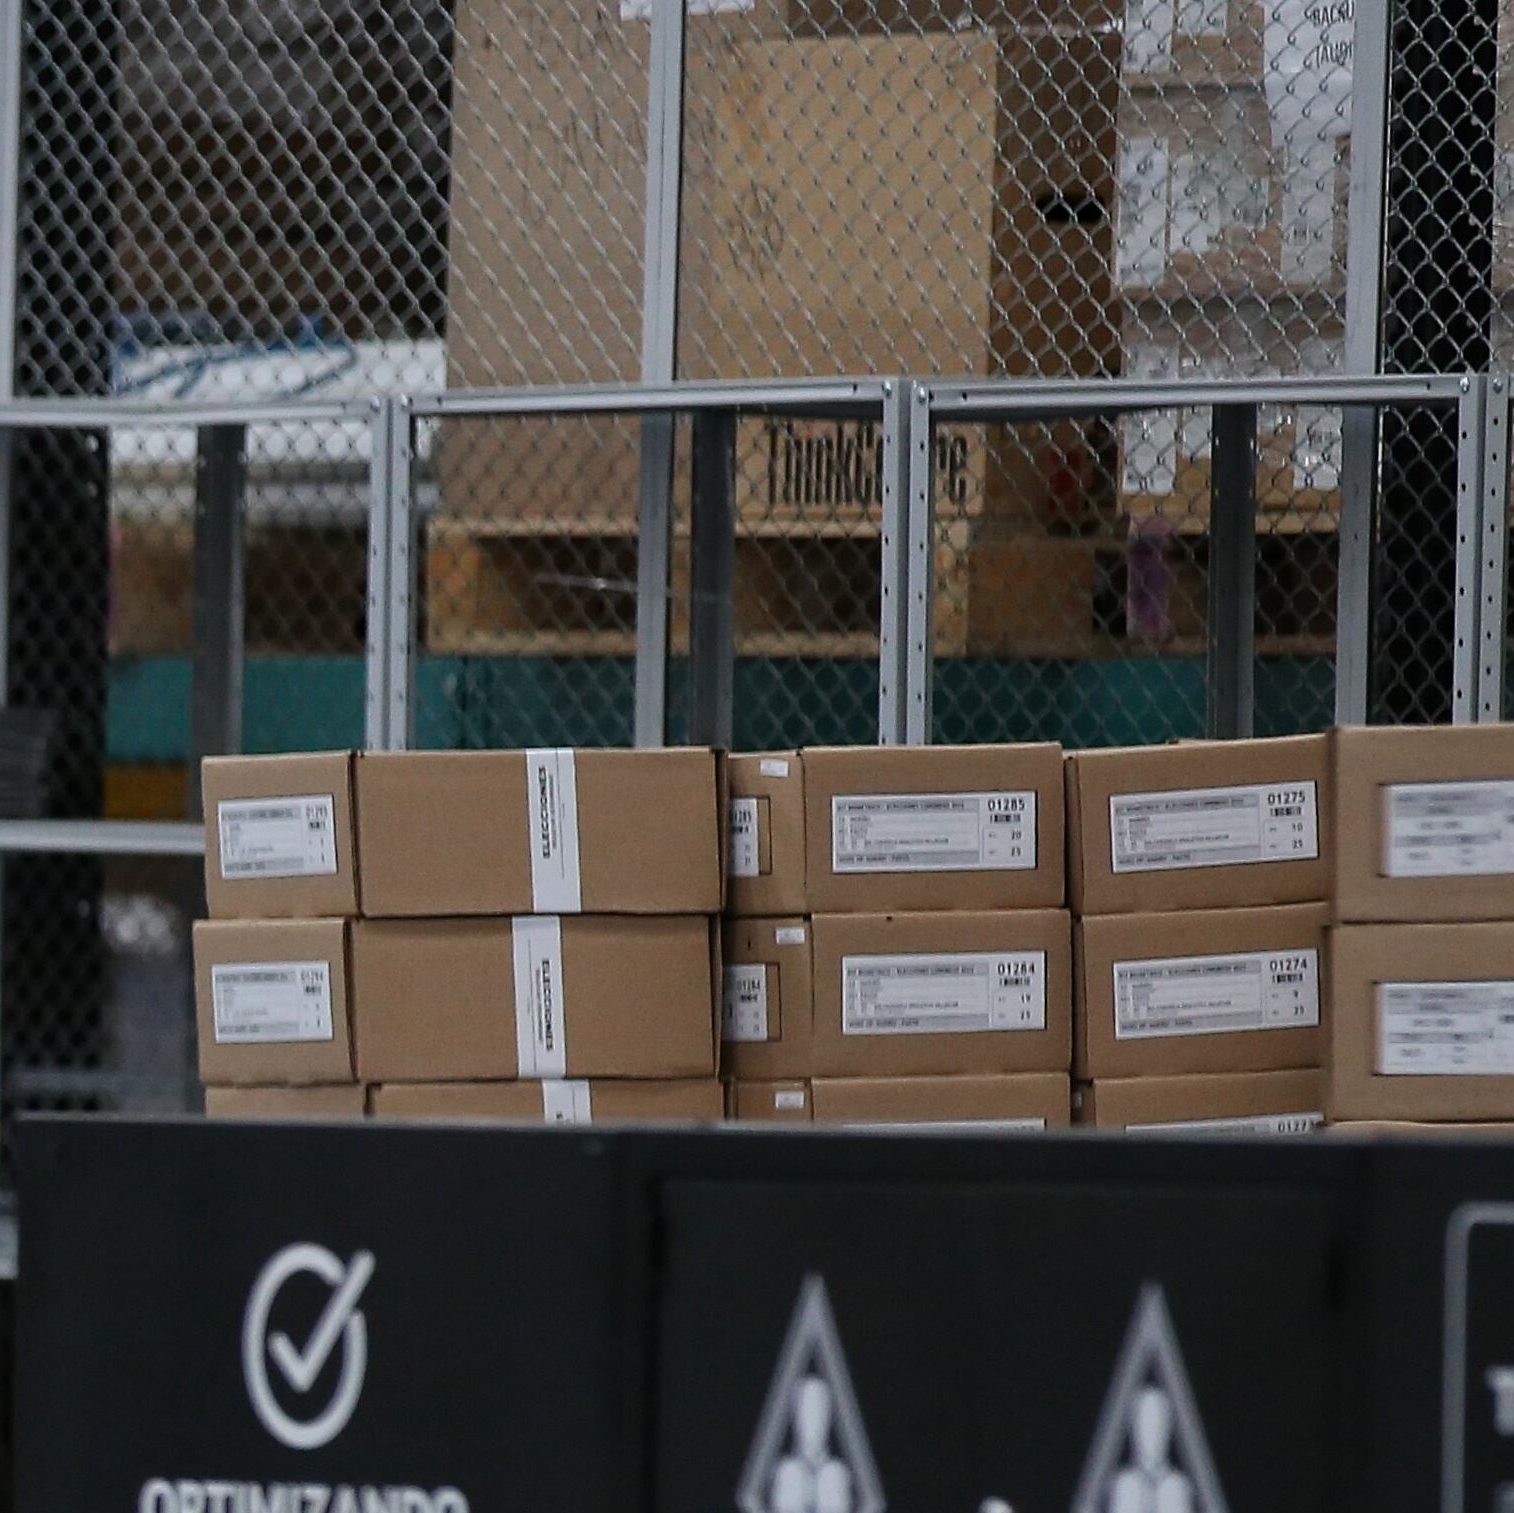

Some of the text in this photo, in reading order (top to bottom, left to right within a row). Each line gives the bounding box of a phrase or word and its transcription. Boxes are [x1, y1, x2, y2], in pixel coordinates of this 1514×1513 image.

[766, 416, 968, 505] ThinkCre
[1267, 790, 1305, 805] 01275
[1269, 957, 1308, 972] 01274
